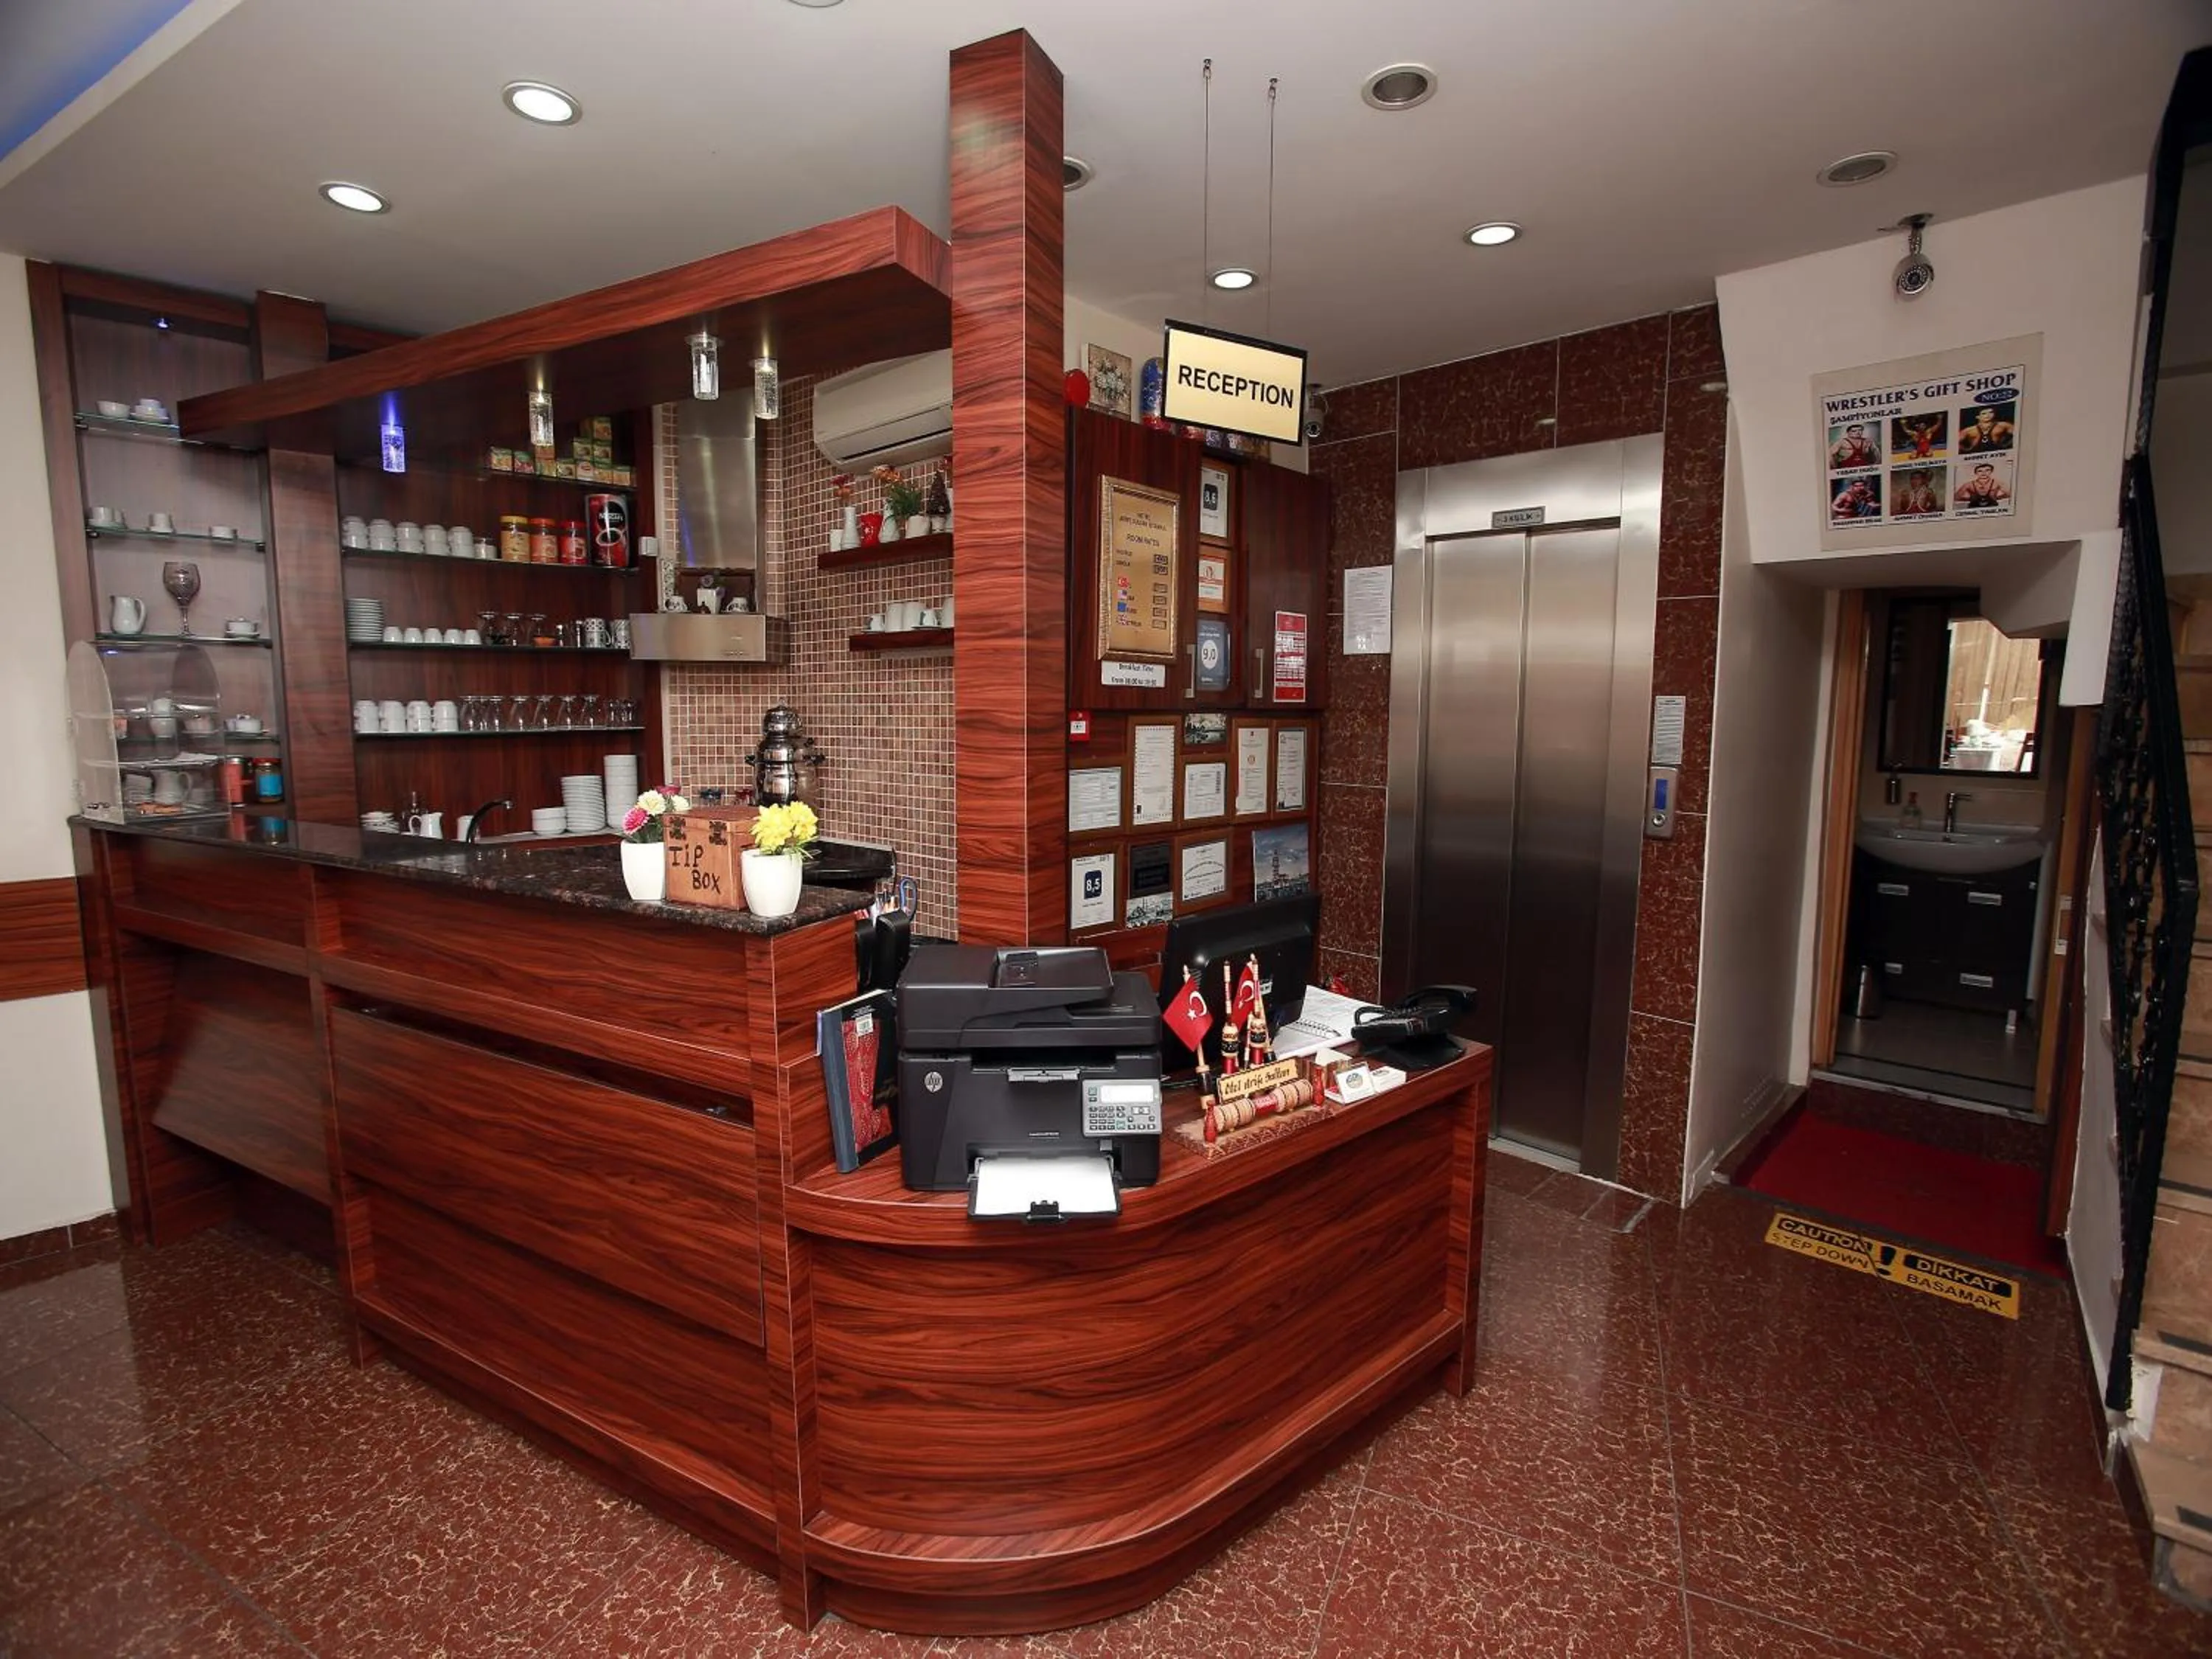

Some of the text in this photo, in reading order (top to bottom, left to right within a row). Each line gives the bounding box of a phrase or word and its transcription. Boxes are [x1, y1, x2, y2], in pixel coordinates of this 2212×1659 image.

[1178, 365, 1294, 408] RECEPTION
[1826, 373, 2016, 413] WRESTLER'S GIFT SHOP
[692, 869, 720, 894] BOX
[1086, 877, 1101, 893] 8,5
[1781, 1219, 1870, 1253] CAUTION
[1815, 1245, 1869, 1270] DOWN
[1907, 1273, 2003, 1311] BASAMAK
